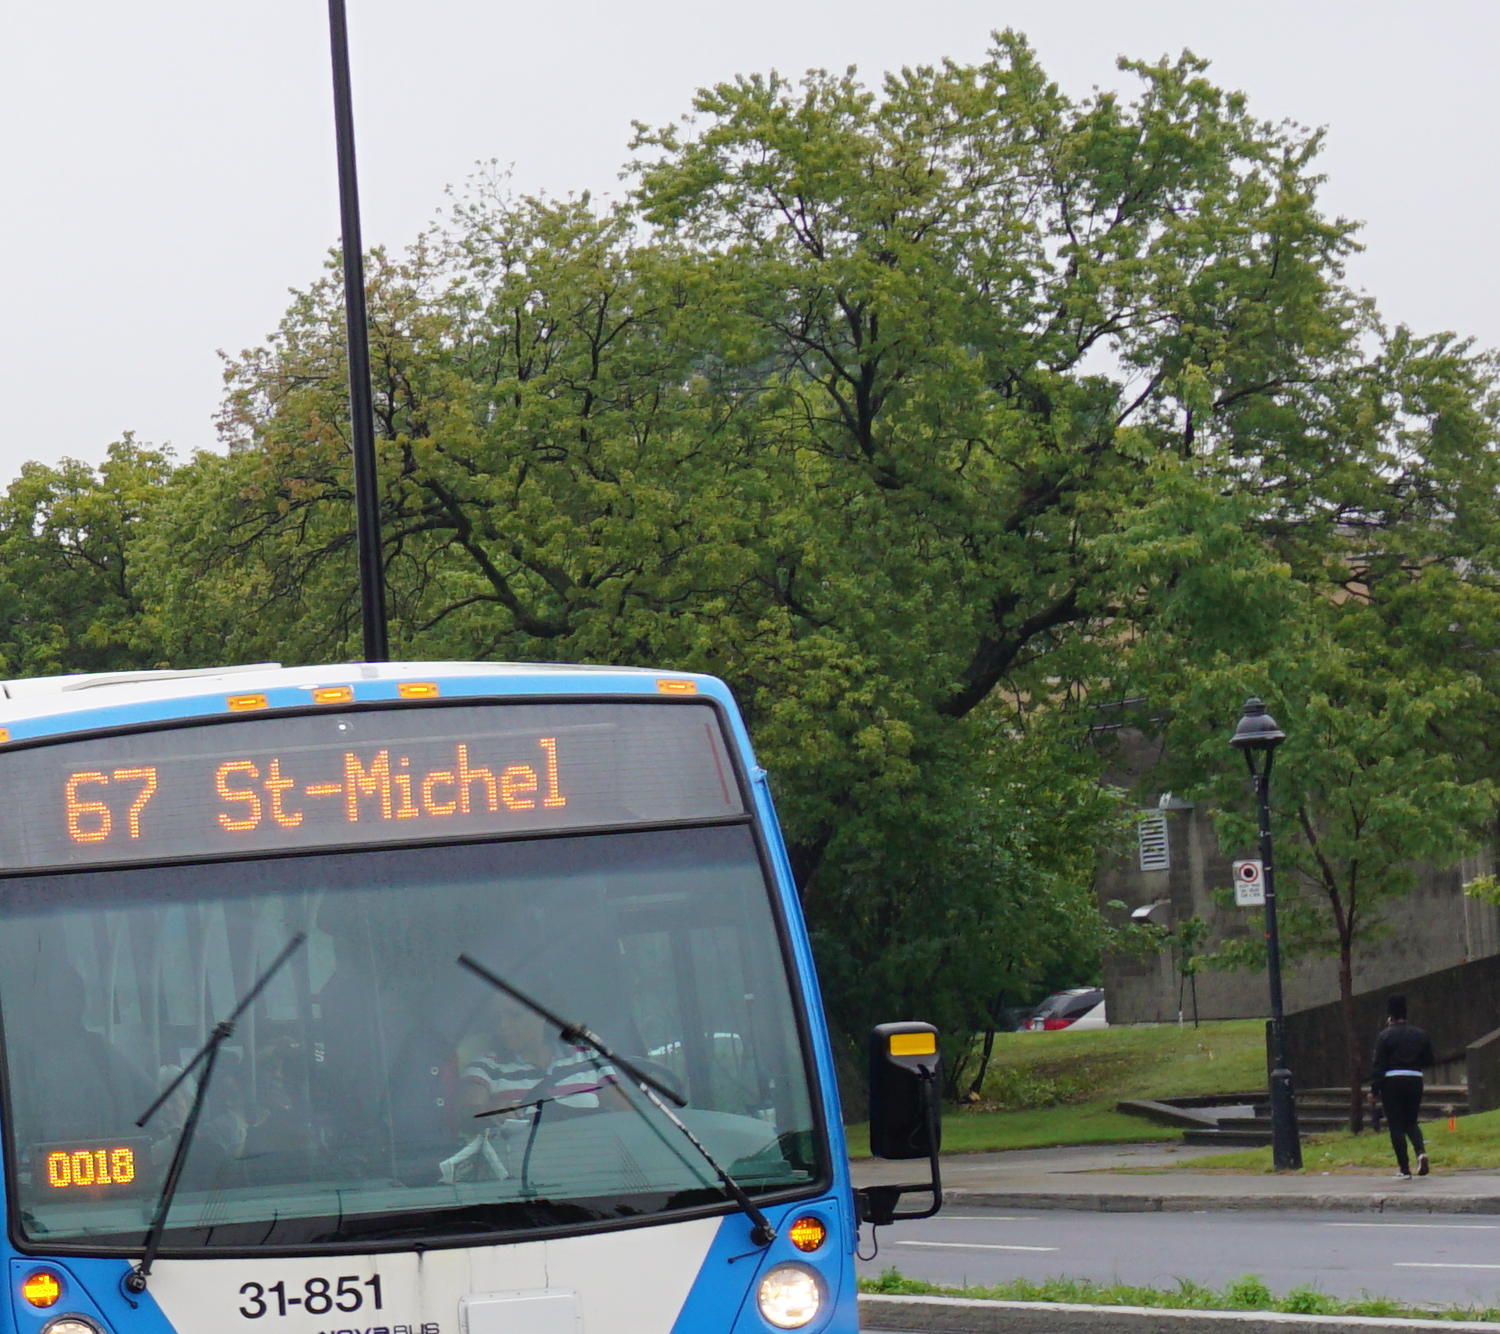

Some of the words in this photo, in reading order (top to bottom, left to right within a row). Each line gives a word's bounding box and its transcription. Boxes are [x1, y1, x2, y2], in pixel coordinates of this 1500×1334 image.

[65, 767, 157, 842] 67
[215, 737, 567, 831] St-Michel
[48, 1148, 135, 1187] 0018
[239, 1273, 382, 1319] 31-851
